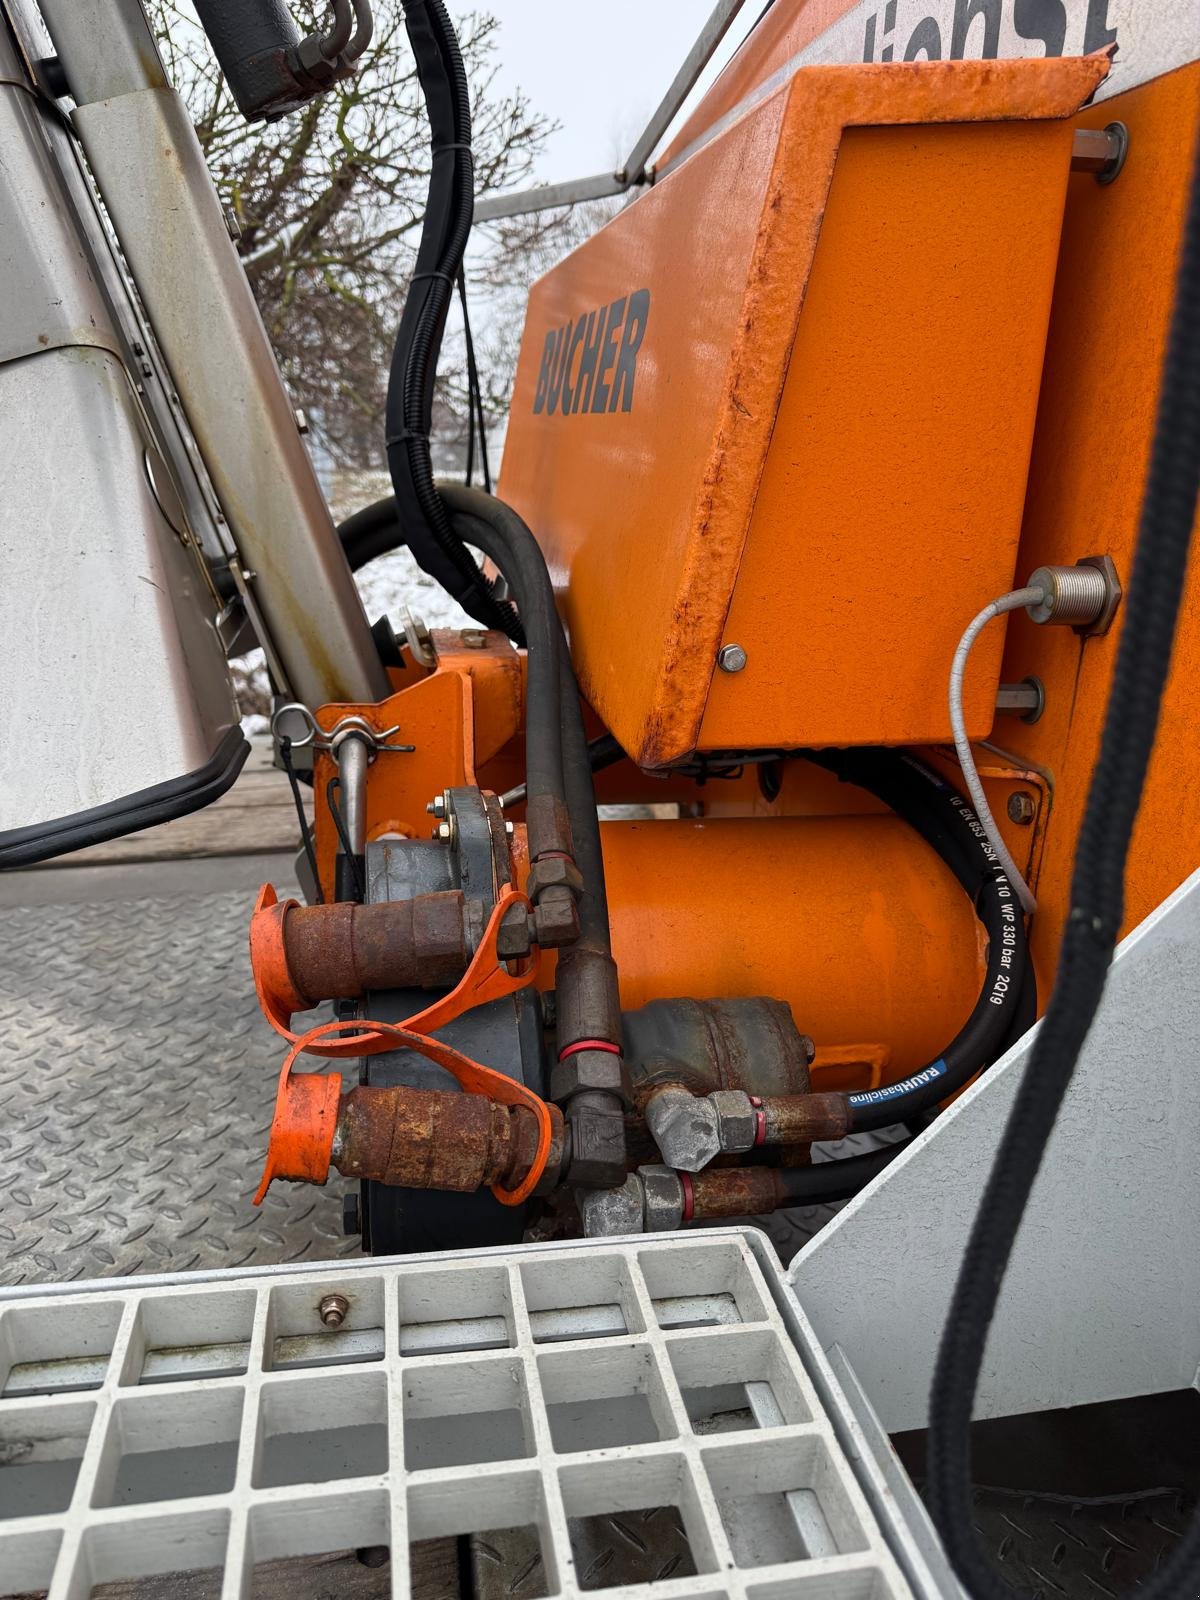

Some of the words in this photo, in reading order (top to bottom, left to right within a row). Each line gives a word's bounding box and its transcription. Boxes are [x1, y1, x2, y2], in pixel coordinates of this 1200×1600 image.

[532, 288, 650, 416] BUCHER
[959, 808, 976, 821] EN
[968, 821, 986, 838] 853
[980, 841, 999, 861] 2SN
[997, 886, 1011, 898] 10
[1001, 903, 1015, 922] WP
[1002, 925, 1016, 946] 330
[1000, 948, 1016, 970] bar
[989, 974, 1011, 1005] 2Q19
